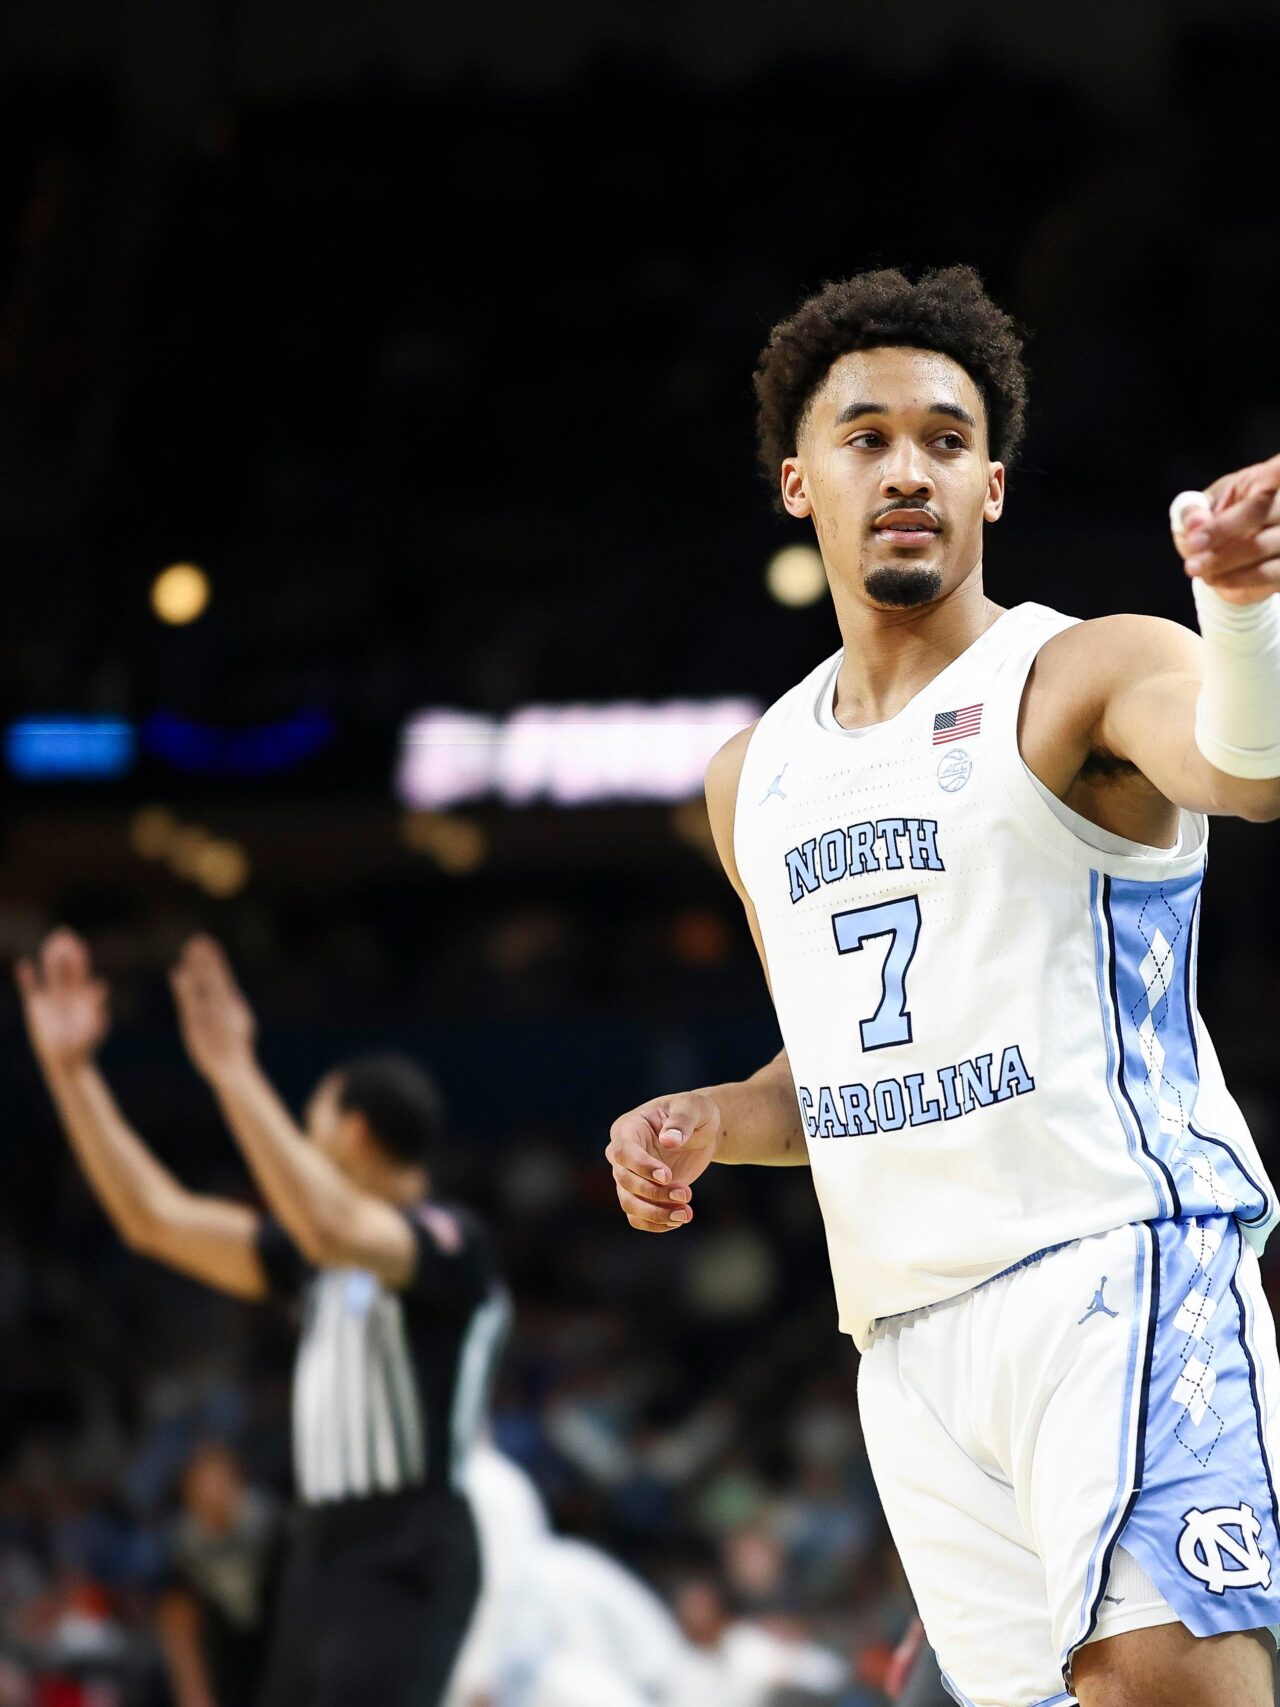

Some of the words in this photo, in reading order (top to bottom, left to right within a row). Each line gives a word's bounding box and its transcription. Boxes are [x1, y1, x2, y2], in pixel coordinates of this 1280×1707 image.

[944, 761, 968, 774] ACC
[785, 818, 945, 904] NORTH
[831, 894, 922, 1053] 7
[799, 1045, 1035, 1138] CAROLINA
